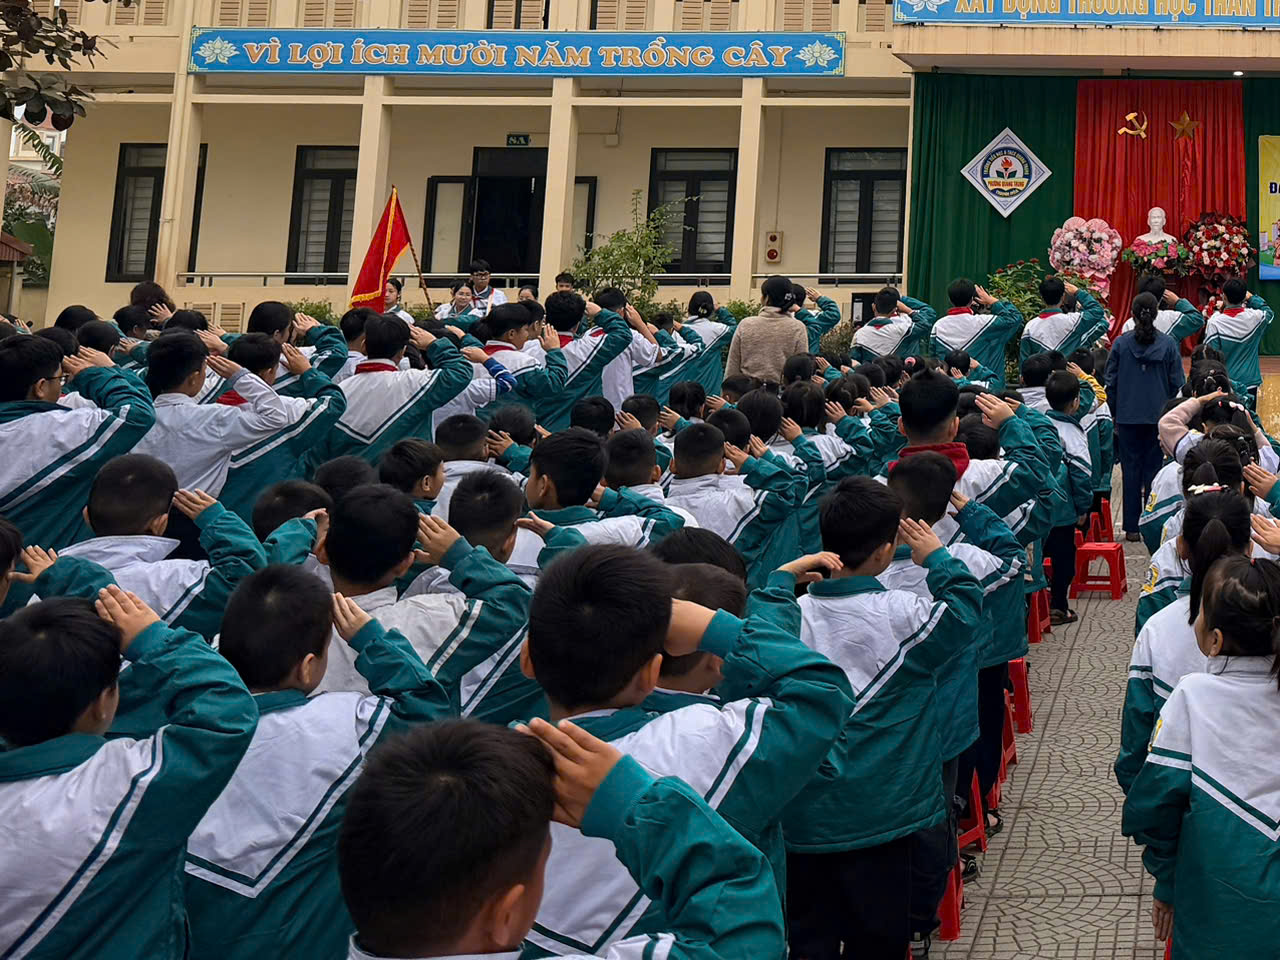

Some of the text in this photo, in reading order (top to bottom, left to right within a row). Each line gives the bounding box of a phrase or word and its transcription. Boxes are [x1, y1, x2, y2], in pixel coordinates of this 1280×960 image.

[243, 36, 793, 69] VÌ LỢI ÍCH MƯỜI NĂM TRỒNG CÂY
